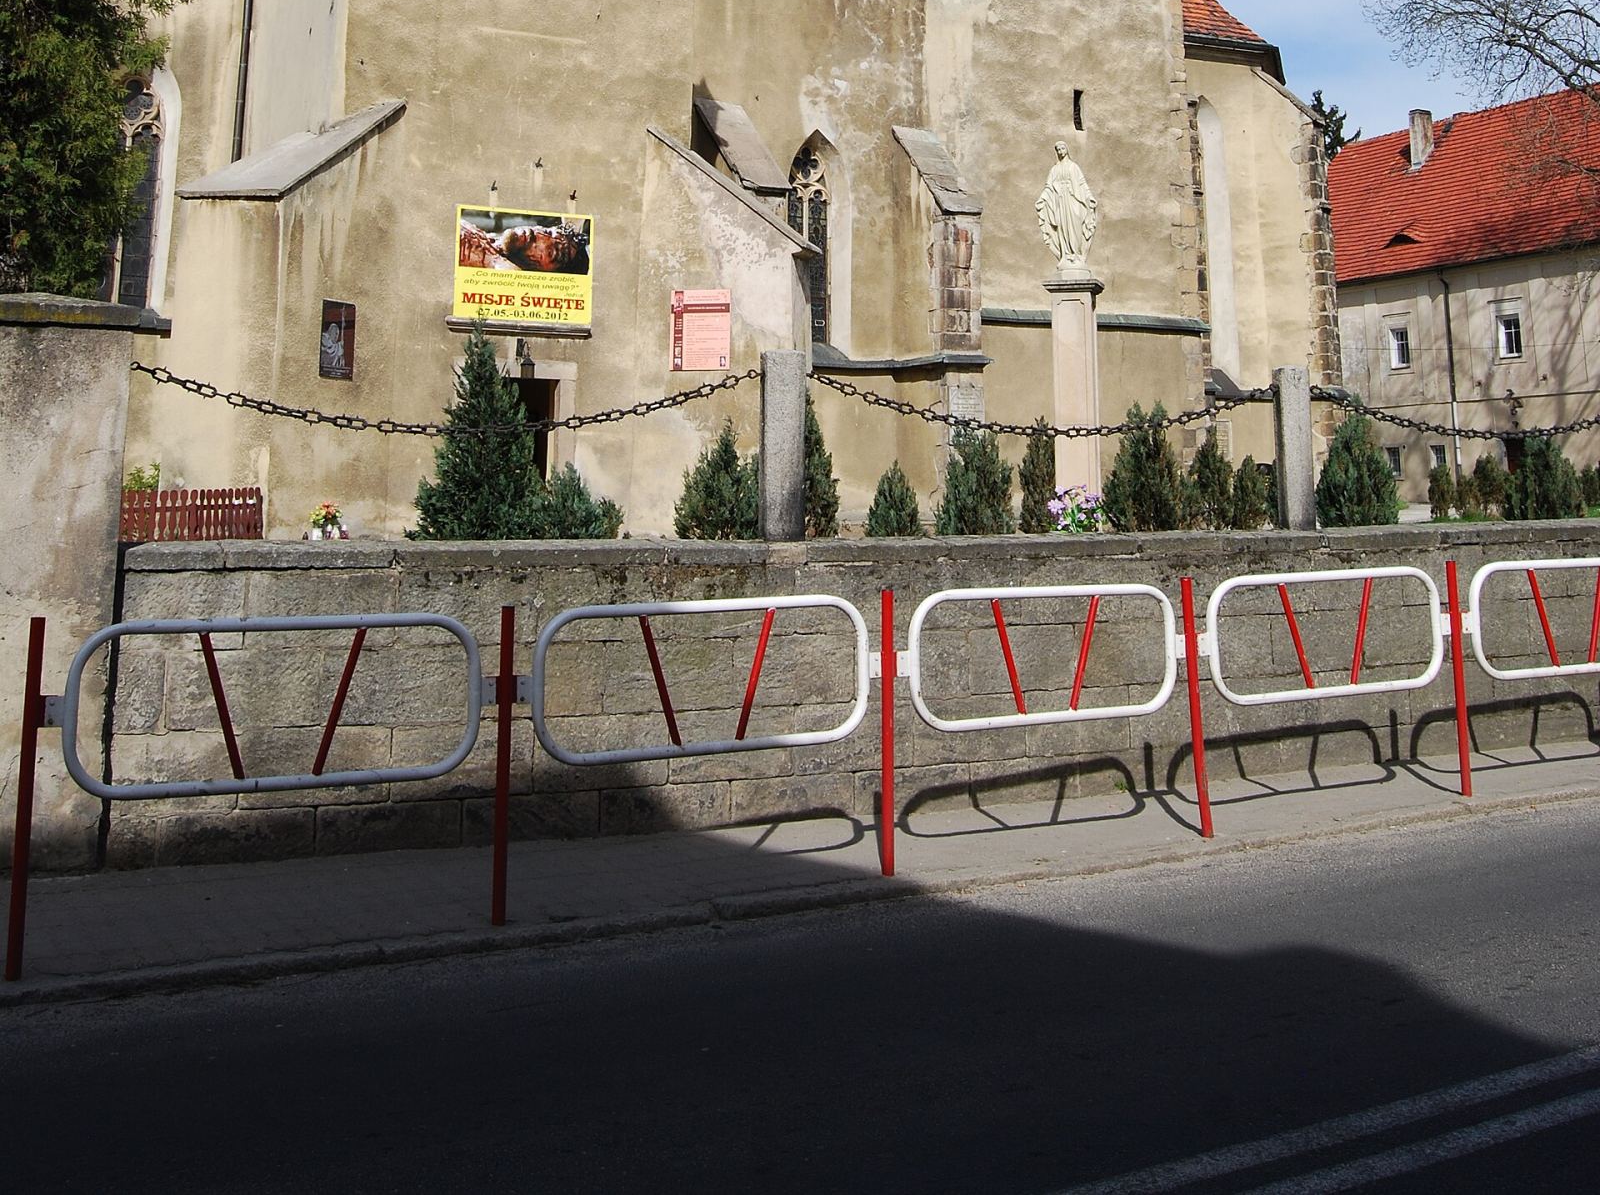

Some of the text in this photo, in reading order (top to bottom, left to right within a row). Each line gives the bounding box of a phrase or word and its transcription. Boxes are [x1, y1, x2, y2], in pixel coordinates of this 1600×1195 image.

[517, 281, 540, 289] twoją
[461, 292, 585, 311] MISJE ŚWIĘTE
[477, 307, 569, 321] 27.05.-03.06.2012
